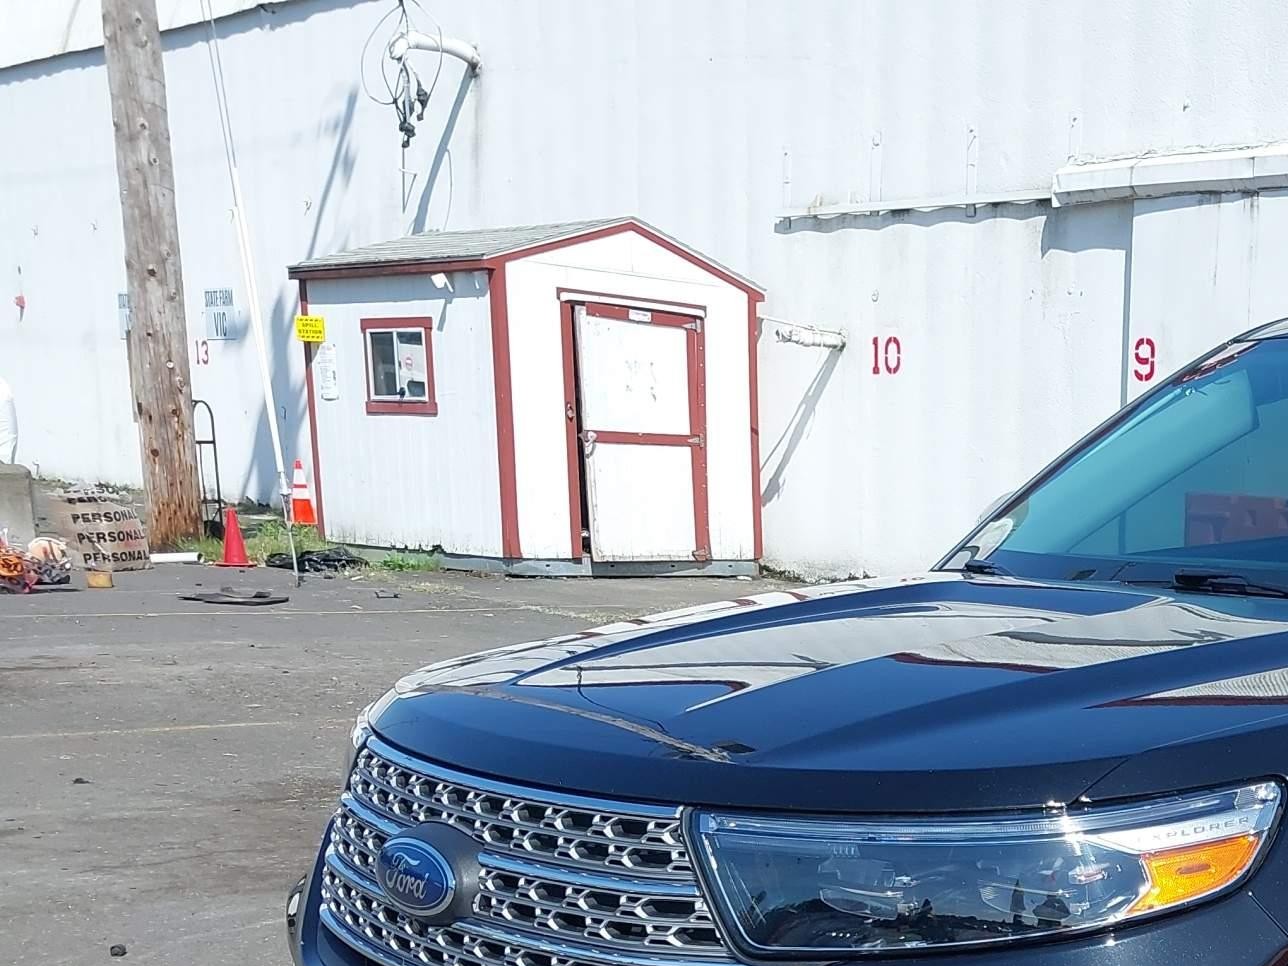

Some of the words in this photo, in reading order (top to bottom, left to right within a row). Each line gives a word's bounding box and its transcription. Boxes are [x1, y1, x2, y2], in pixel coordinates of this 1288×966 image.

[194, 339, 210, 365] 13
[872, 336, 901, 375] 10
[1134, 337, 1156, 382] 9
[83, 549, 149, 564] PERSONAL
[1137, 815, 1249, 843] XPLORER
[386, 852, 431, 899] Ford
